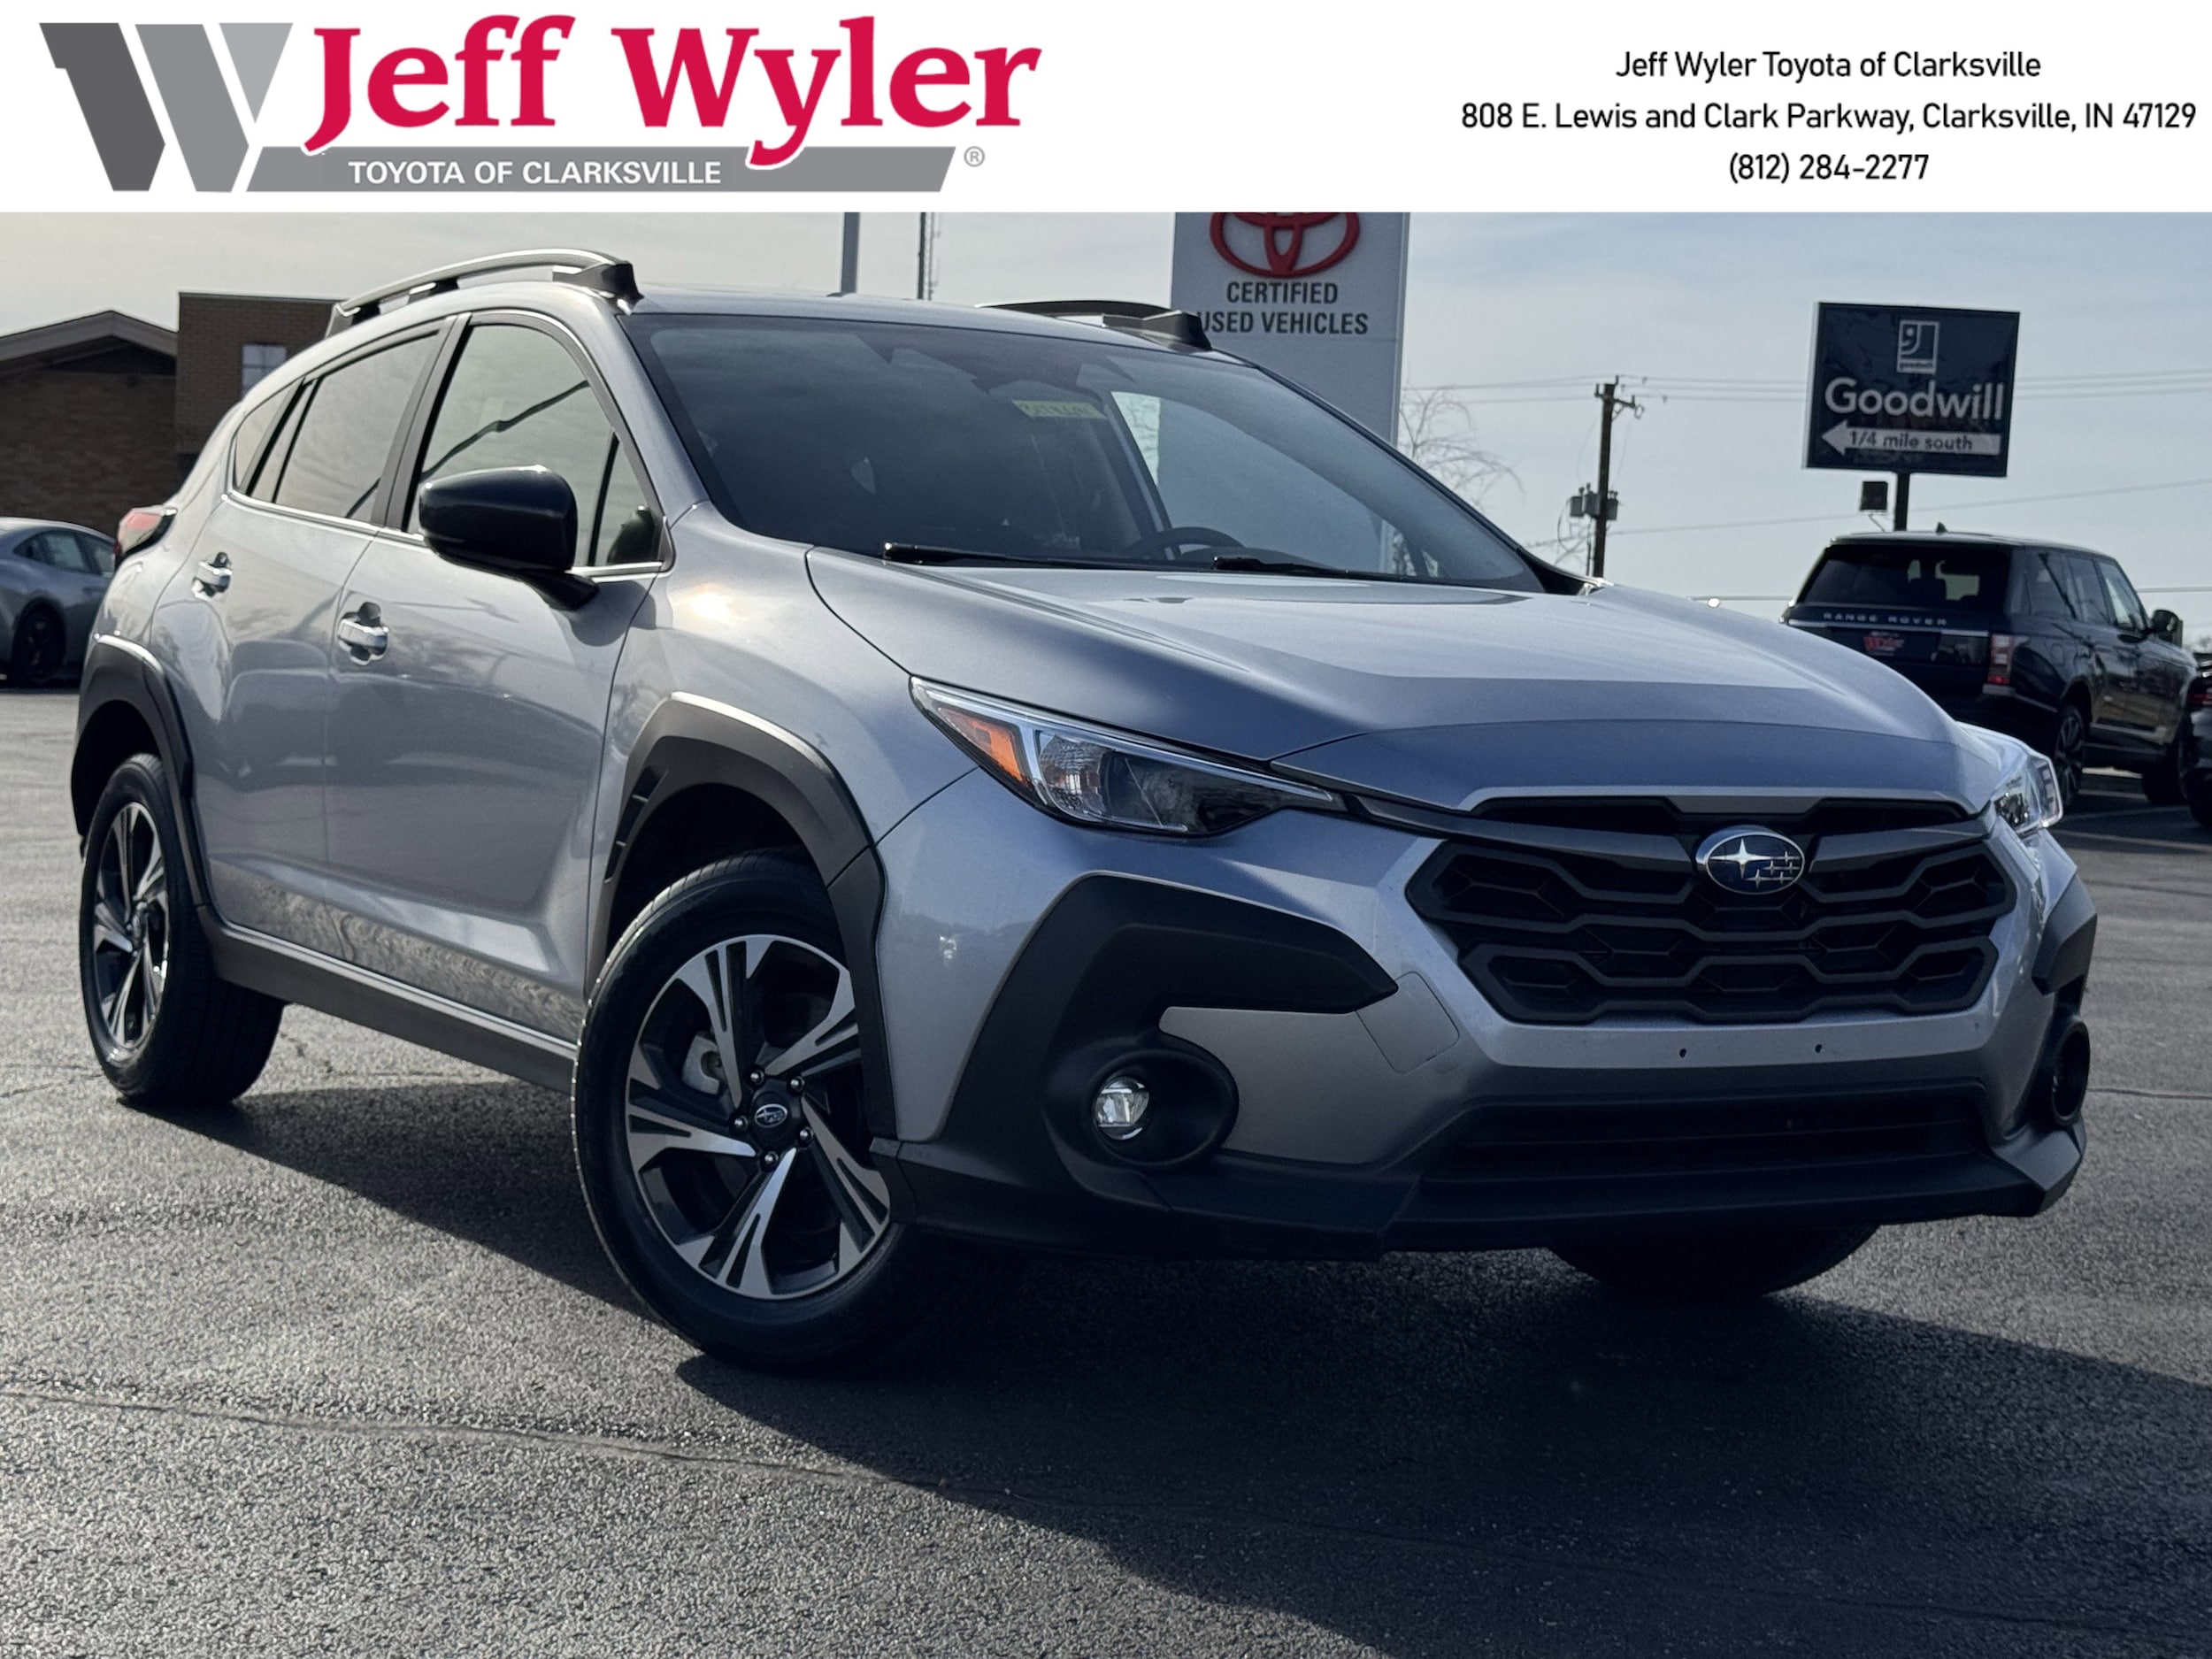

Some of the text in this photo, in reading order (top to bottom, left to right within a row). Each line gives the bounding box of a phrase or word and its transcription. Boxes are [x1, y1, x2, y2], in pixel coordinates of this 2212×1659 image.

[1226, 281, 1339, 303] CERTIFIED
[1261, 312, 1369, 334] VEHICLES
[1824, 377, 2005, 420] Goodwill
[1849, 430, 1972, 451] 1/4 mile south
